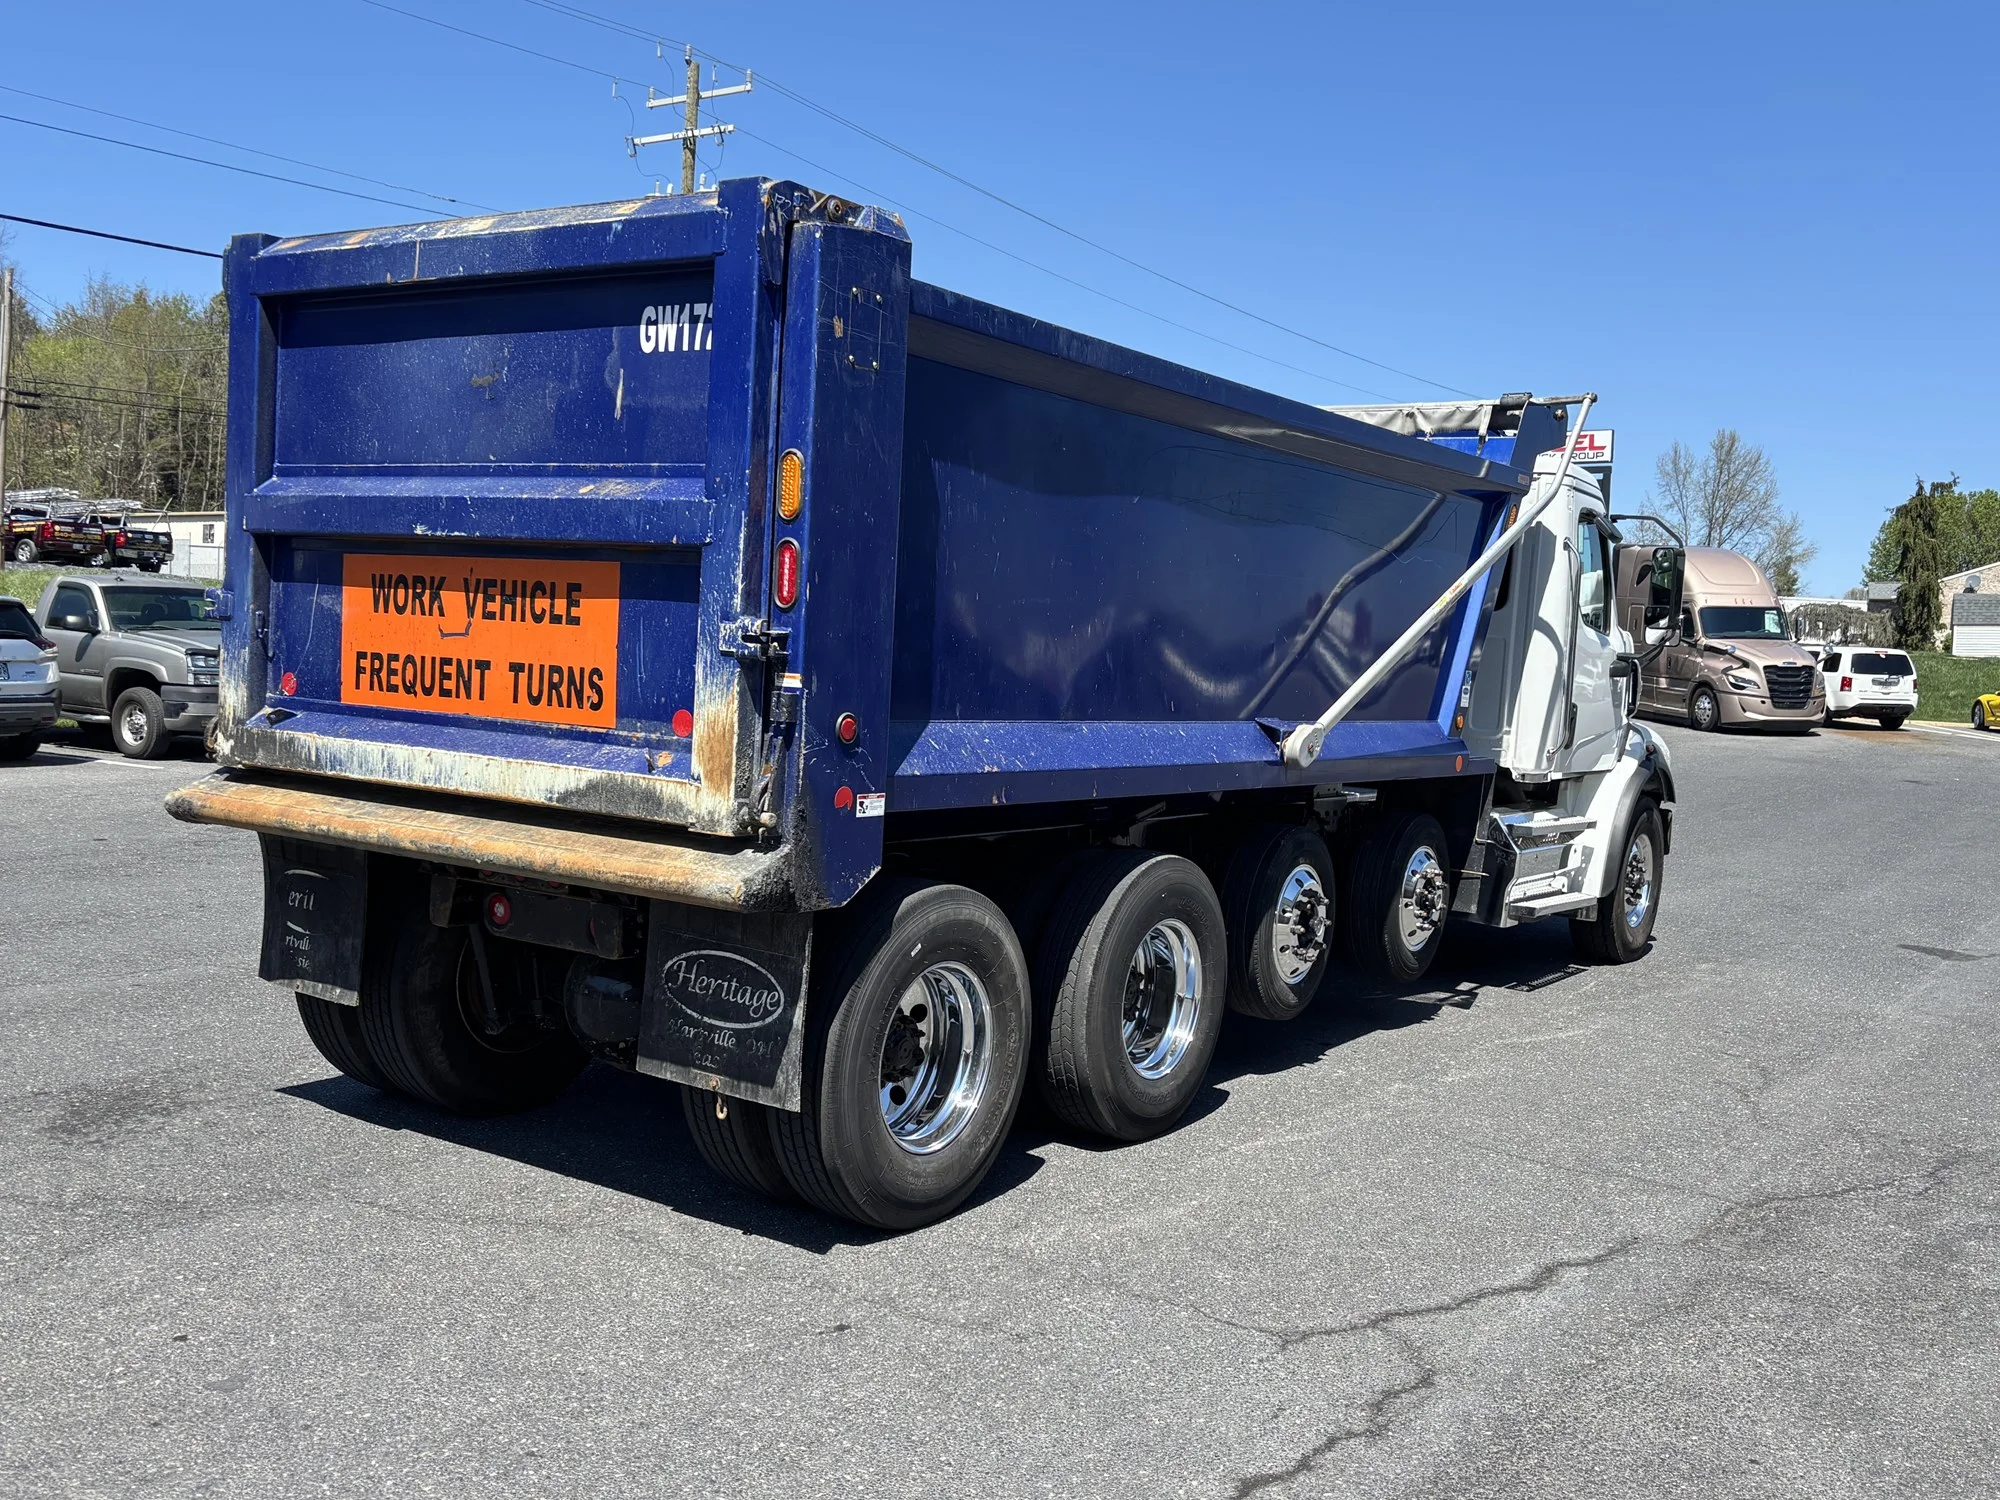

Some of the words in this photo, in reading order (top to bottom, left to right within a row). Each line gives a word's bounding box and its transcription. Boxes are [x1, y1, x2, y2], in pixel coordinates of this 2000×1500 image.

[371, 573, 447, 617] WORK
[463, 577, 582, 626] VEHICLE
[355, 651, 491, 701] FREQUENT
[509, 661, 604, 712] TURNS
[669, 959, 779, 1018] Heritage
